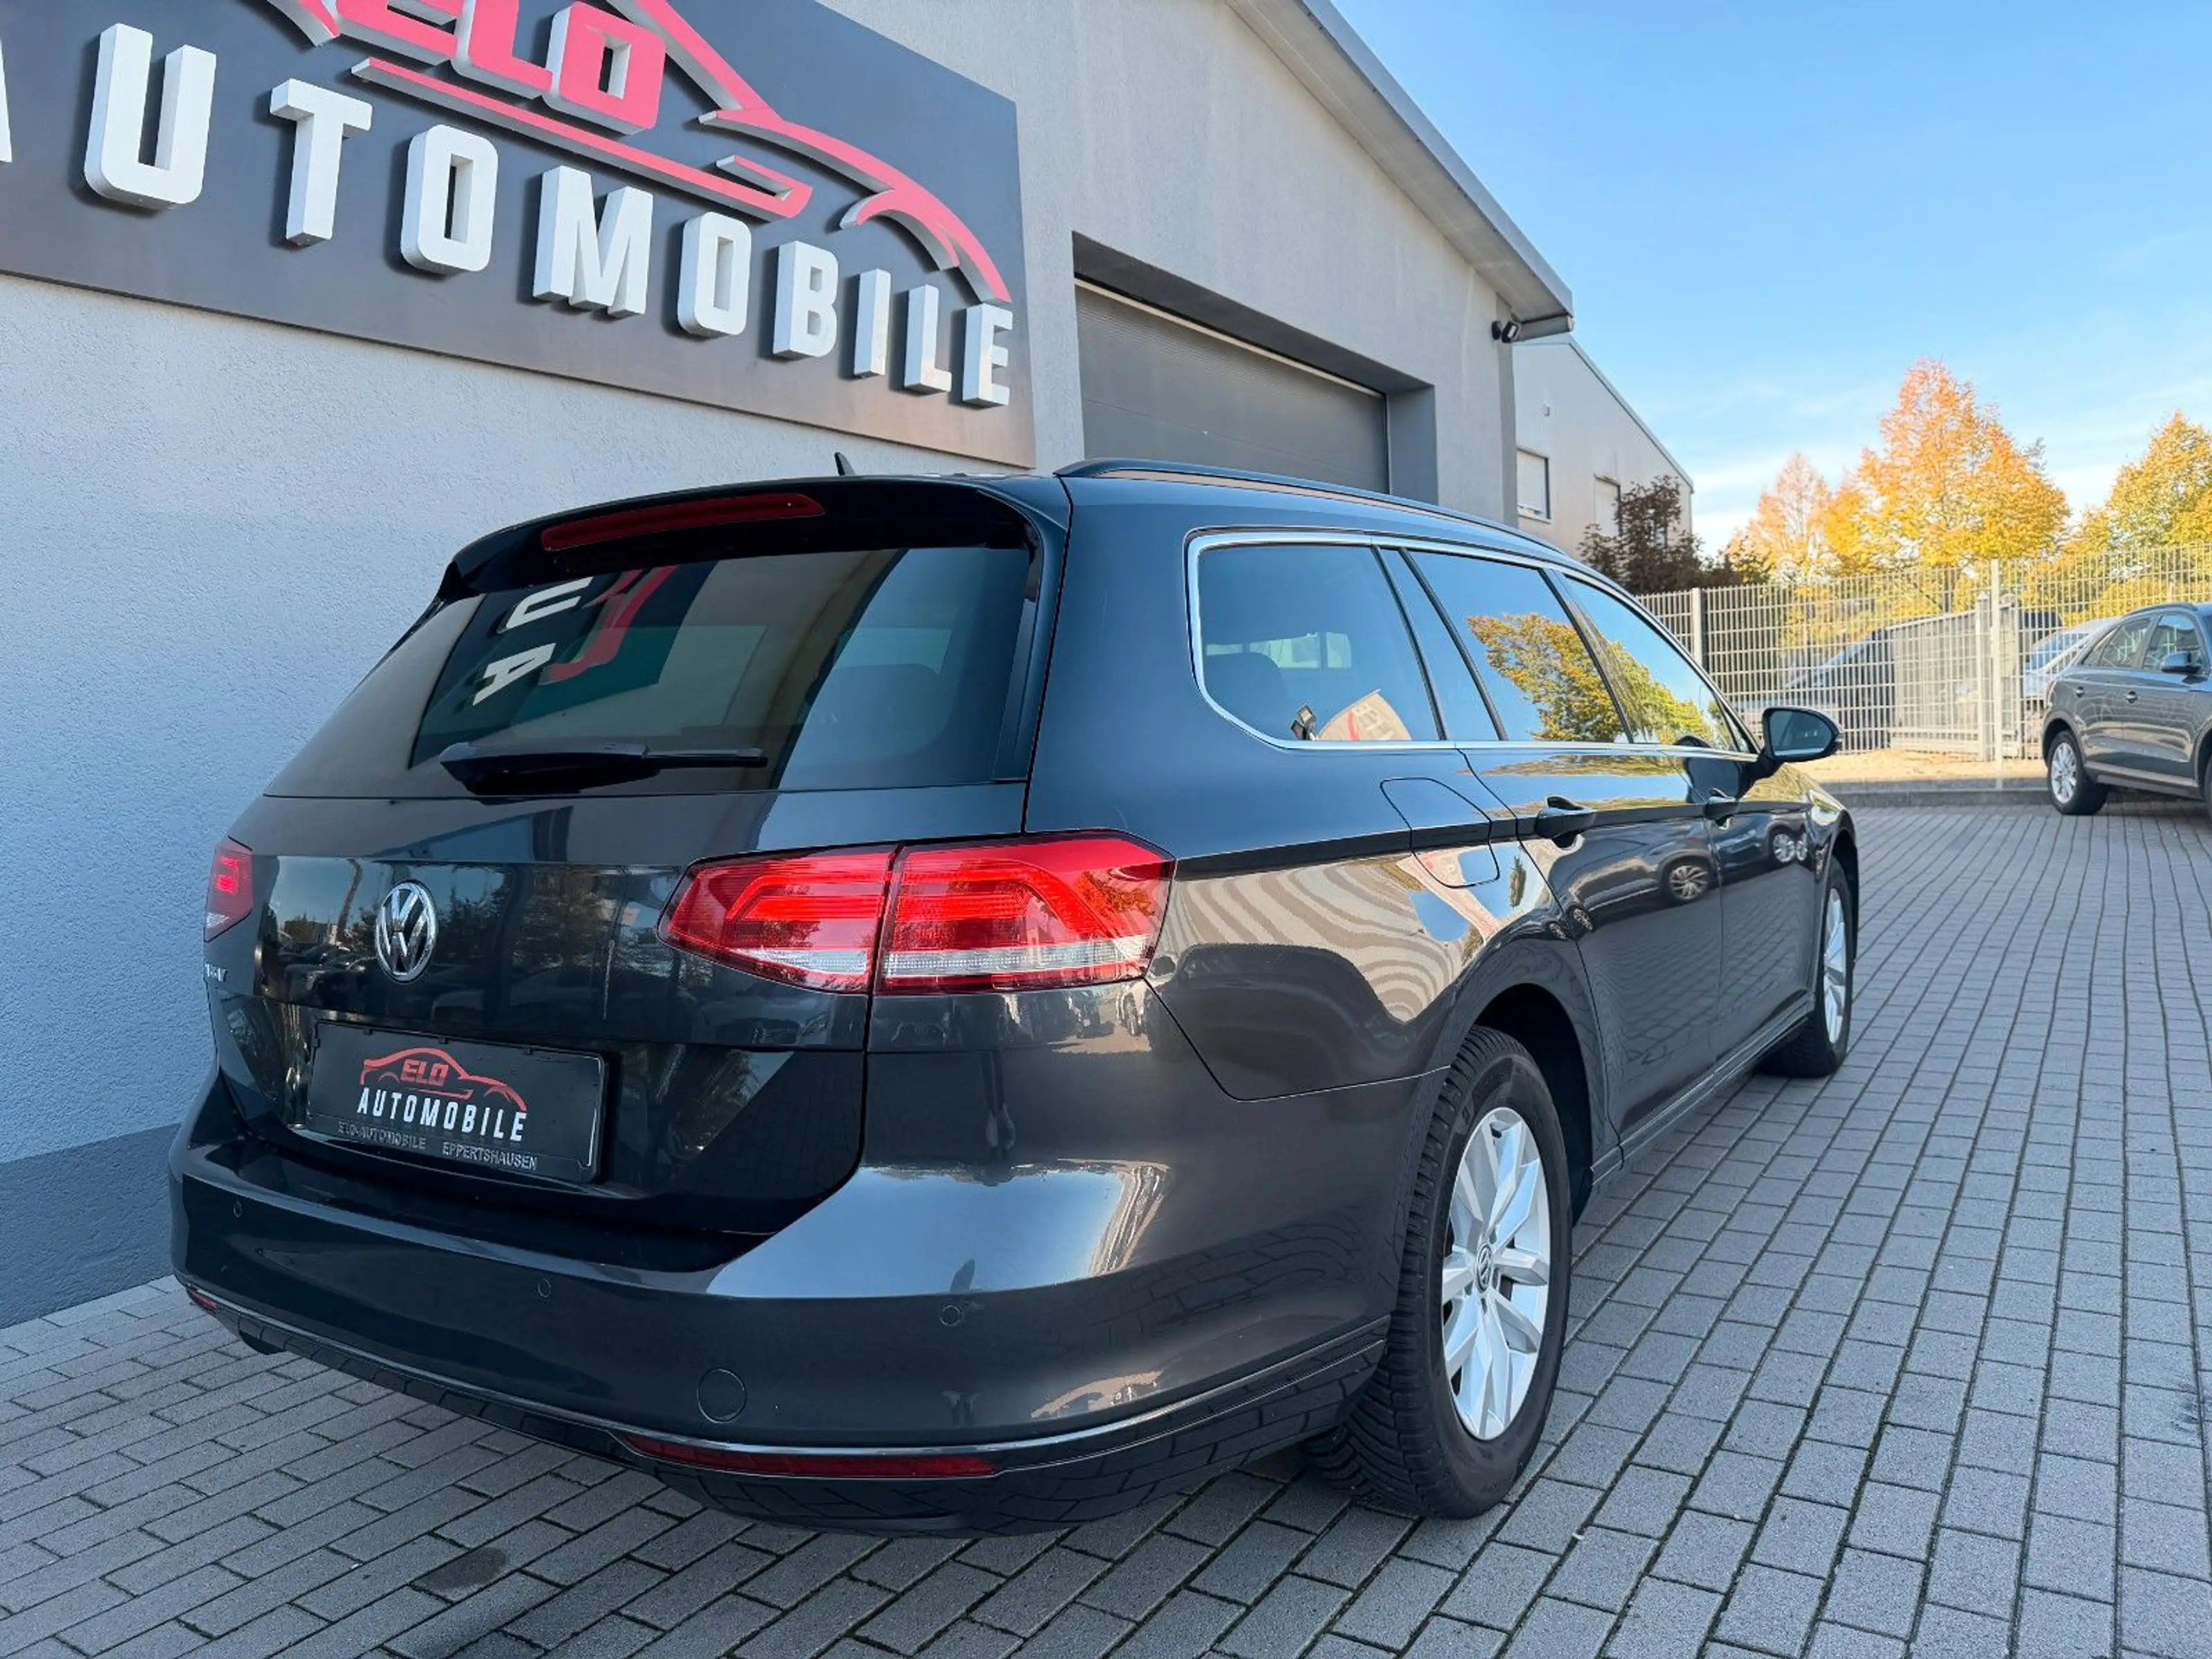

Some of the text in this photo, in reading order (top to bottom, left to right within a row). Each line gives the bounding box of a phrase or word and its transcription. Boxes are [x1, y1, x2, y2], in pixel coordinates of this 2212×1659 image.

[0, 23, 1013, 408] UTOMOBILE
[402, 1060, 449, 1086] ELO
[357, 1088, 527, 1141] AUTOMOBILE
[442, 1141, 538, 1171] EPPERTSHAUSEN
